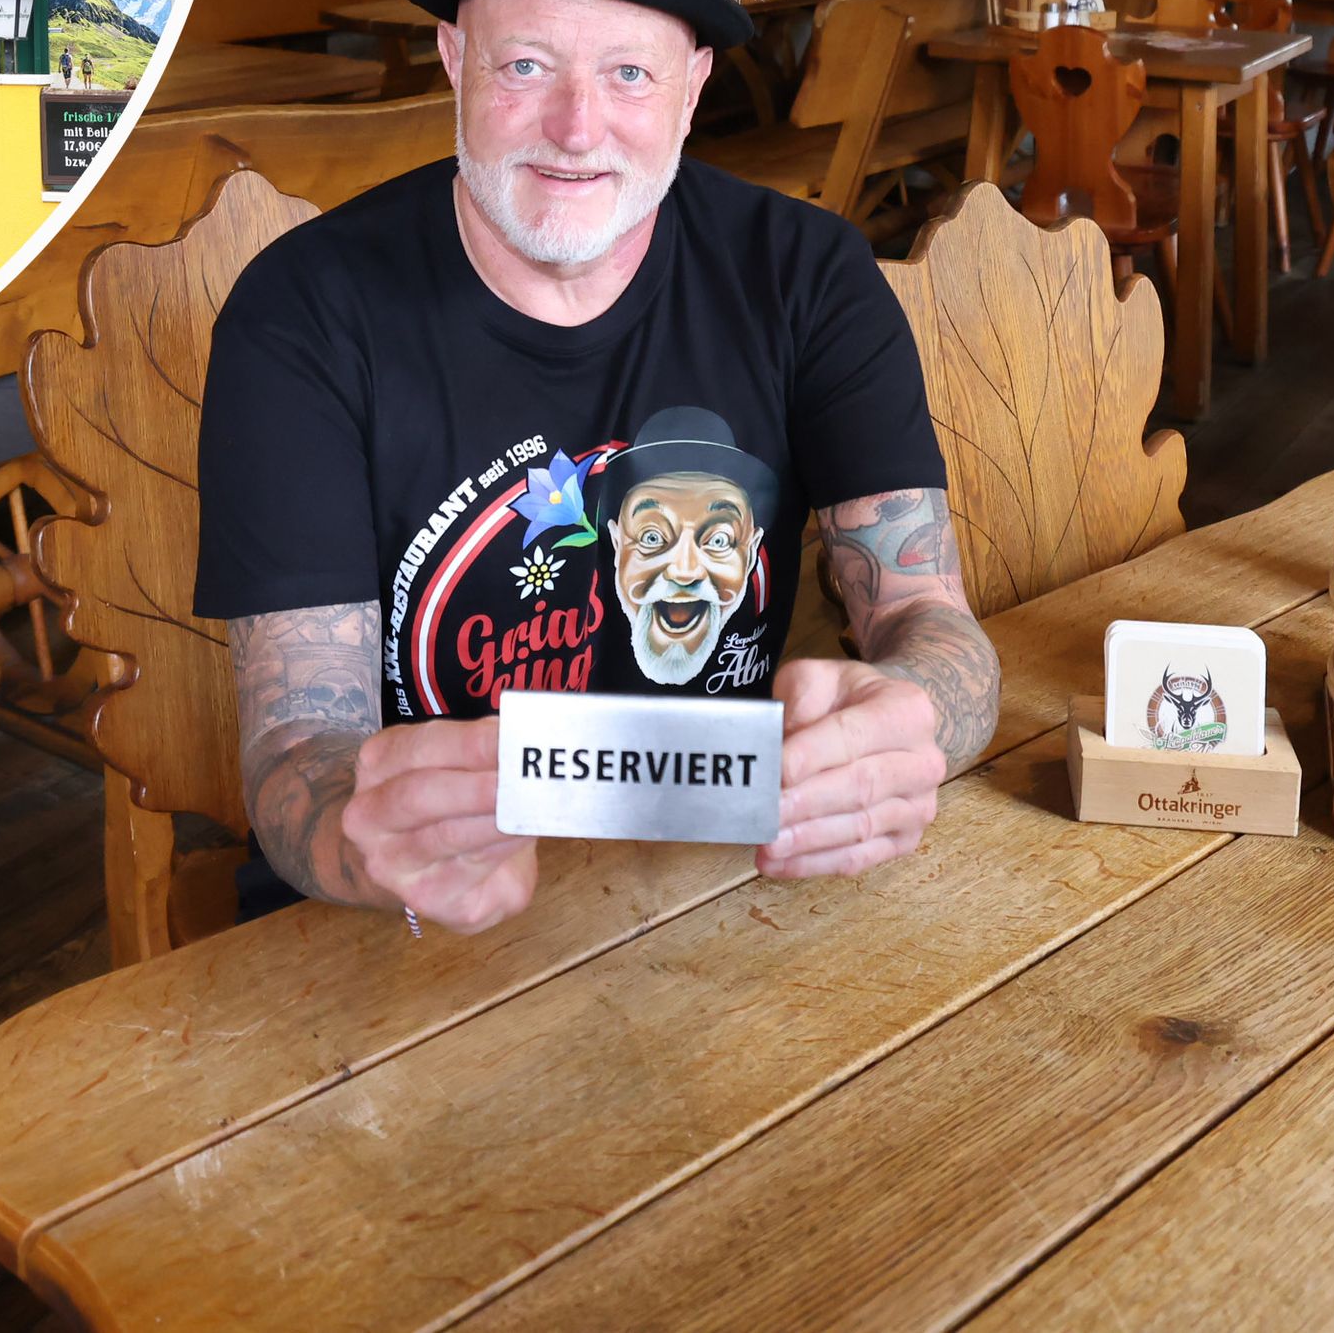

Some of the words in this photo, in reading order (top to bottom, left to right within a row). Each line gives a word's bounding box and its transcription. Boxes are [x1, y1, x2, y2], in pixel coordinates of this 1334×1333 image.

[63, 111, 103, 123] frische
[63, 126, 84, 137] mit
[86, 126, 112, 138] Beil
[63, 140, 102, 152] 17,90€
[64, 156, 89, 167] bzw.
[505, 435, 548, 468] 1996
[478, 459, 509, 489] seit
[384, 476, 479, 684] XXL-RESTAURANT
[706, 644, 770, 694] Alm
[397, 686, 414, 716] Das
[521, 746, 758, 788] RESERVIERT
[1137, 793, 1242, 820] Ottakringer
